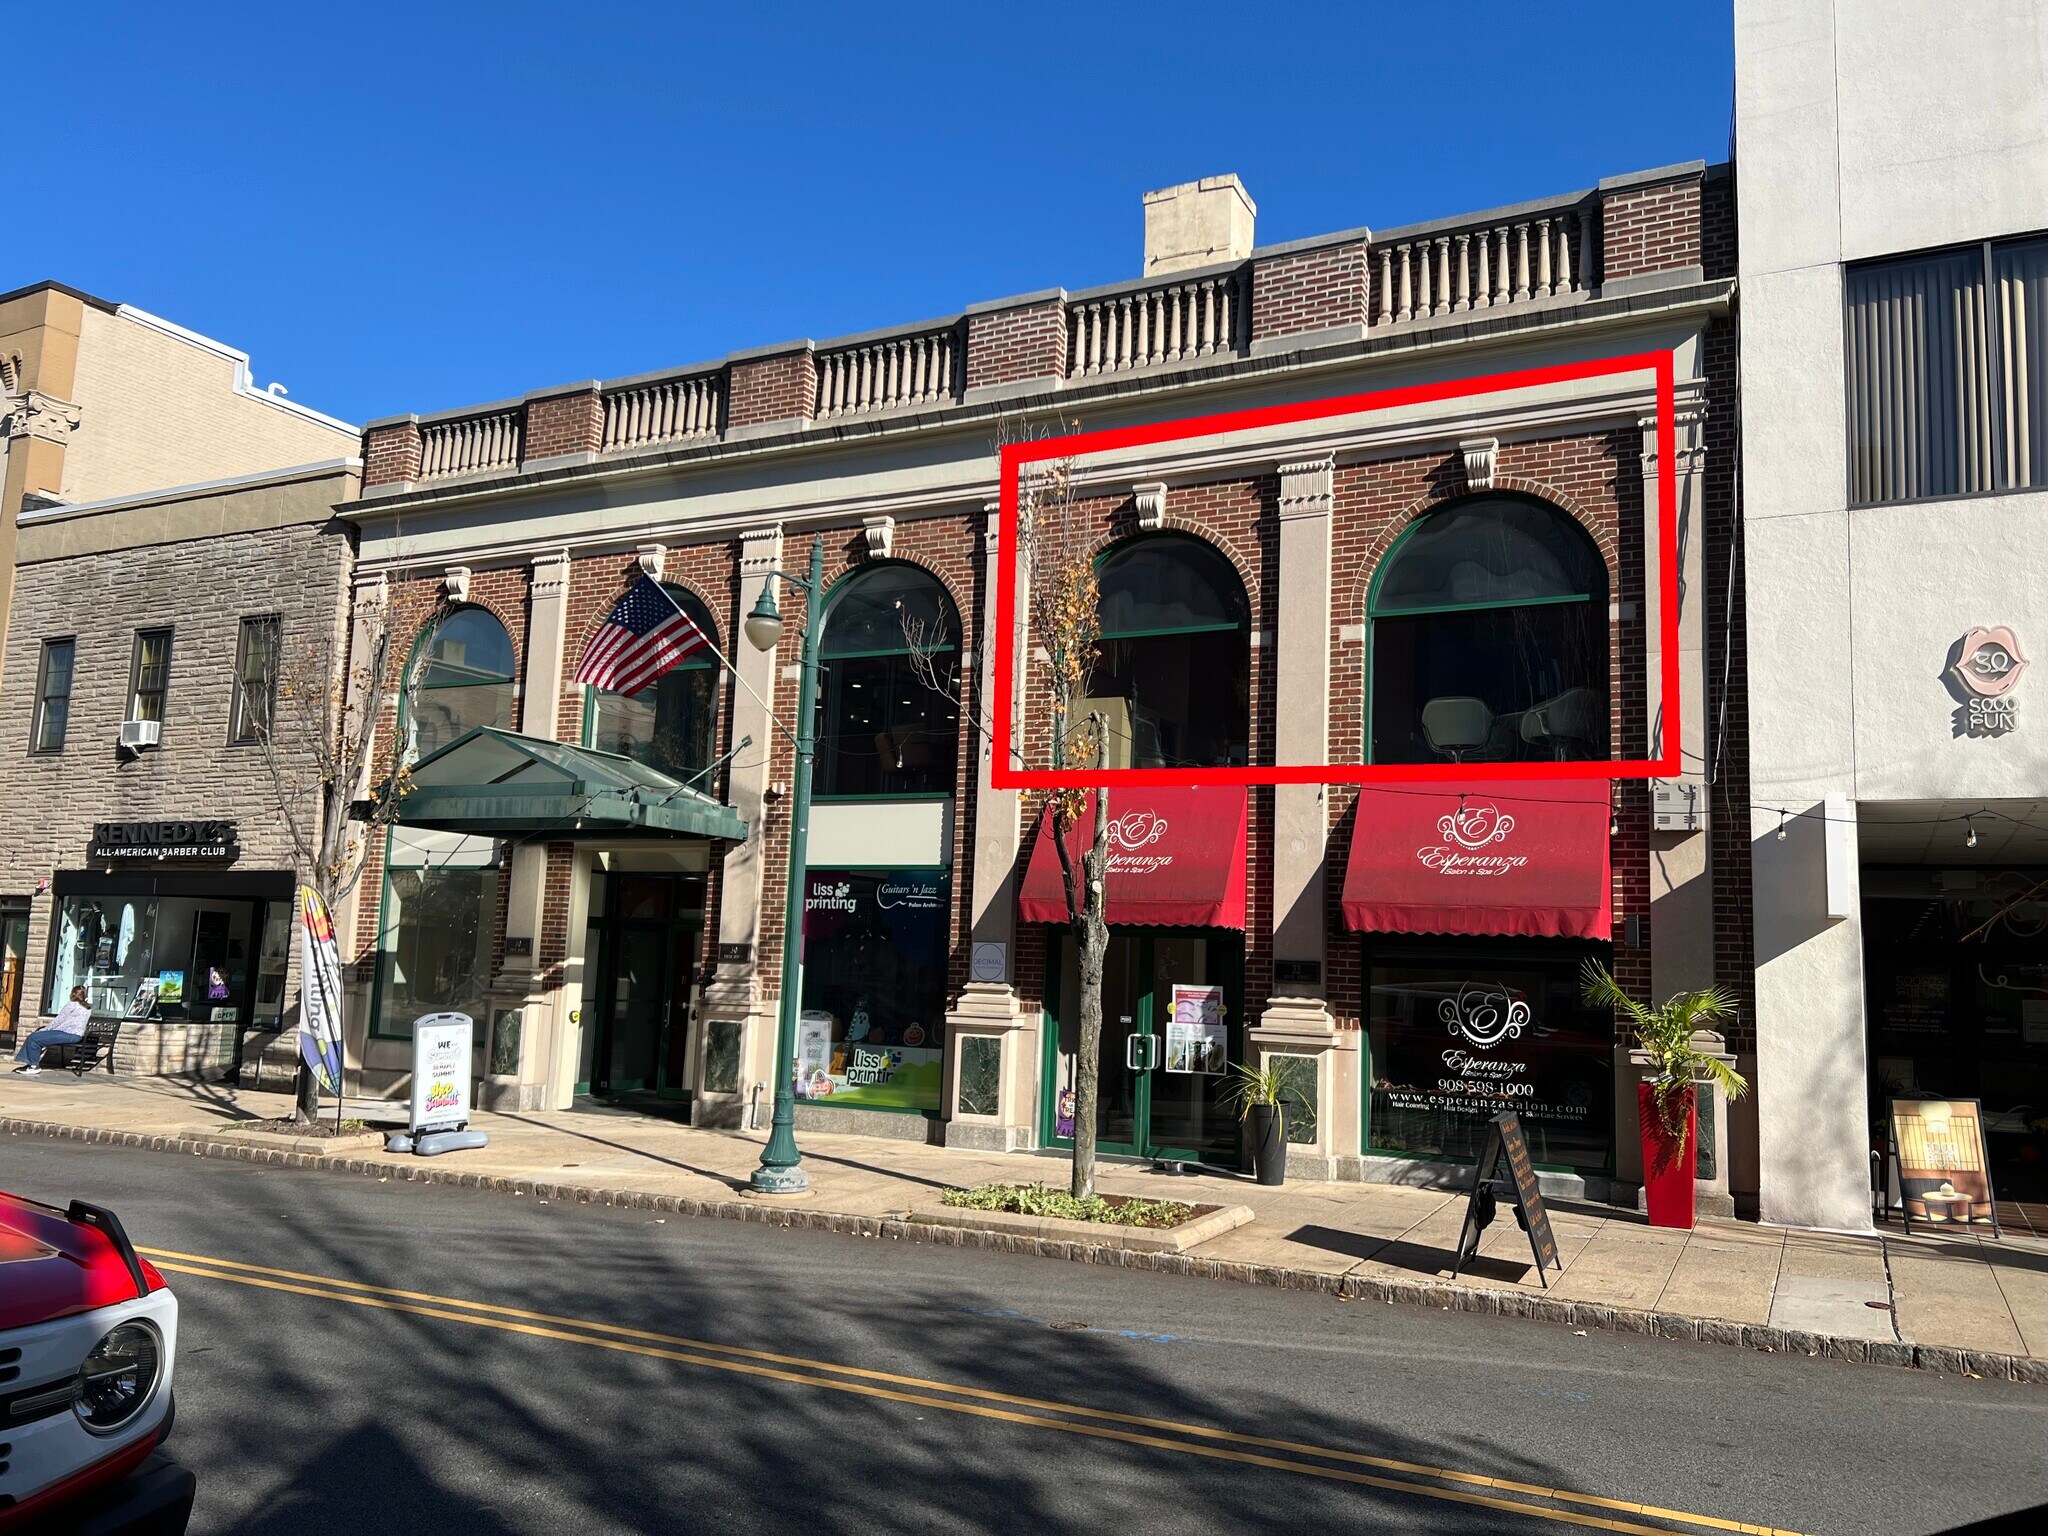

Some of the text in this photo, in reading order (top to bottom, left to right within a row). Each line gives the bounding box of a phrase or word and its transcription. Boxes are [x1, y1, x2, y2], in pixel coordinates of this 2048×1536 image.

[1970, 712, 2019, 731] FUN
[94, 821, 229, 844] KENNEDY'S
[95, 847, 226, 857] ALL-AMERICAN BARBER CLUB
[1417, 846, 1528, 875] Esperanza
[1106, 853, 1173, 873] speranza
[1476, 868, 1493, 876] Spa
[813, 883, 834, 896] liss
[882, 884, 910, 894] Guitars
[919, 884, 937, 895] Jazz
[805, 896, 857, 913] printing
[438, 1041, 451, 1049] WE
[855, 1050, 880, 1068] liss
[1442, 1049, 1527, 1079] Esperanza
[1489, 1071, 1502, 1079] Spa
[1388, 1093, 1587, 1114] www.esperanzasalon.com
[1405, 1102, 1430, 1110] Coloring
[1556, 1113, 1583, 1121] Services
